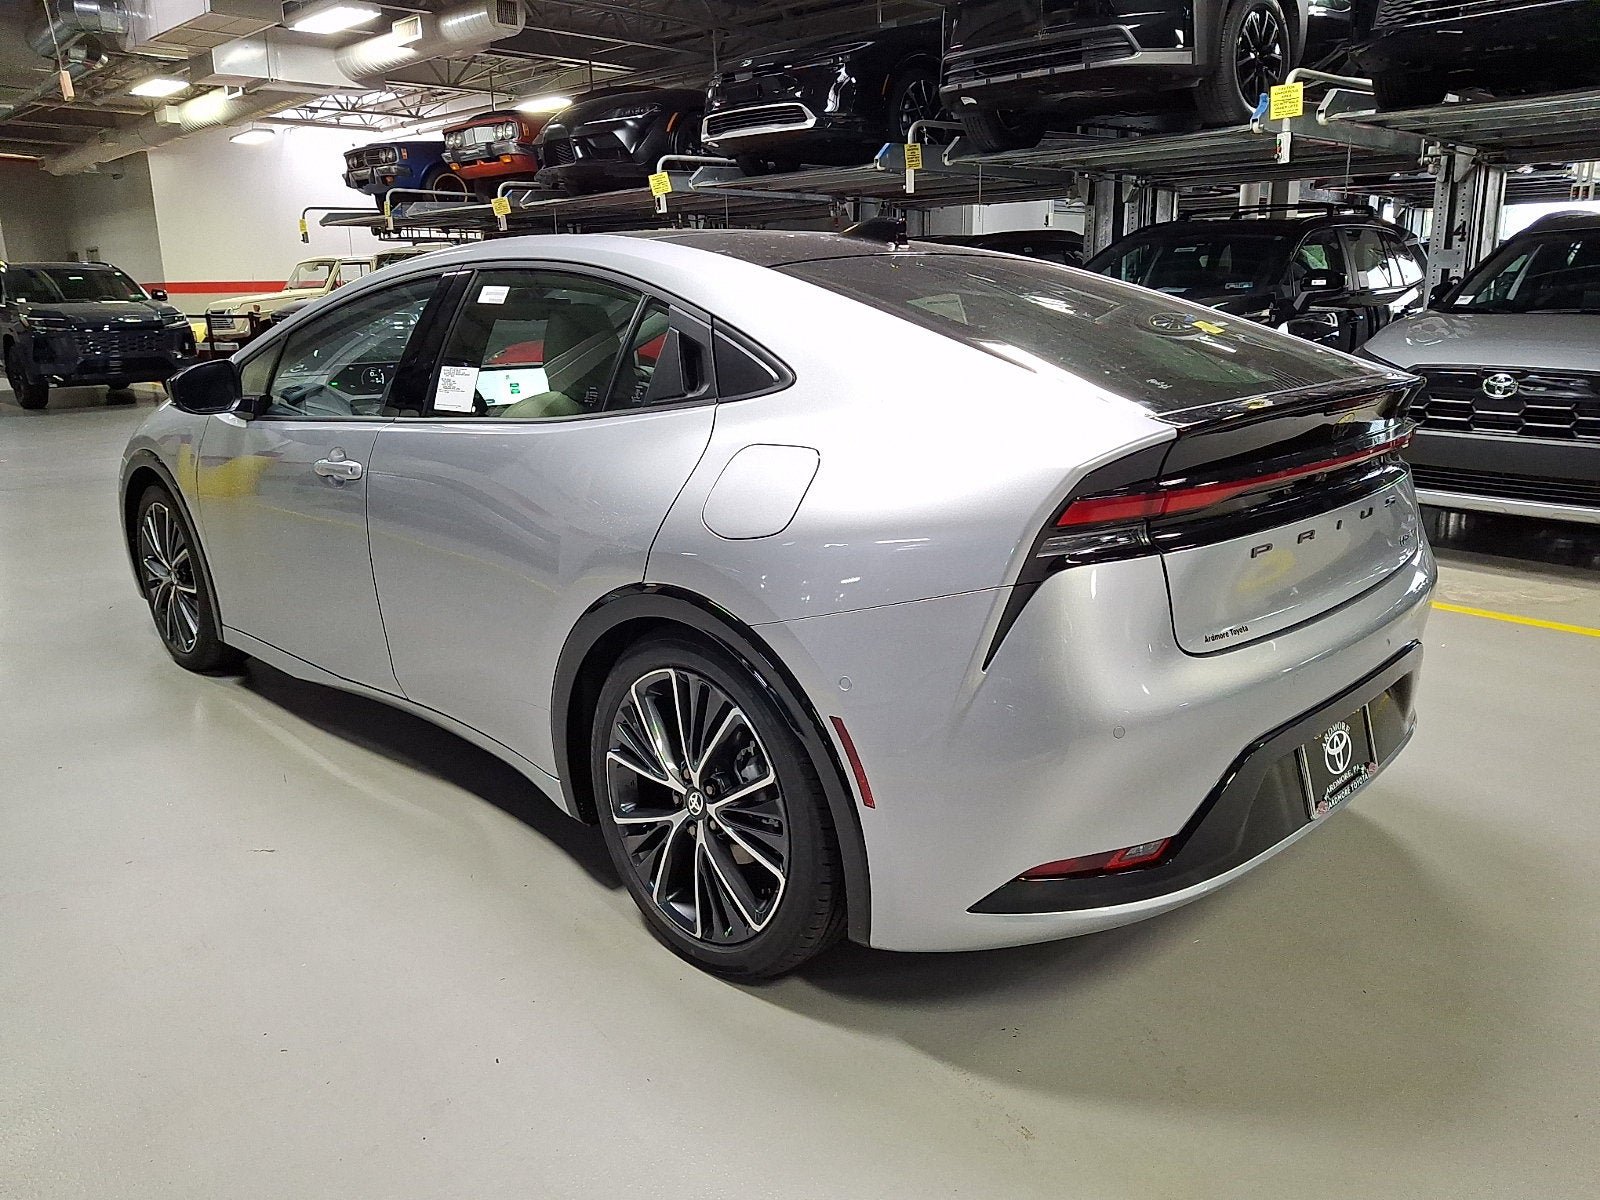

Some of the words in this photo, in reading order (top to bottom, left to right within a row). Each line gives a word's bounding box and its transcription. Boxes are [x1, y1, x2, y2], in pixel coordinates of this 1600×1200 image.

[1452, 220, 1467, 242] 4
[1250, 494, 1397, 559] PRIUS
[1204, 631, 1230, 643] Ardmore
[1229, 625, 1249, 636] Toyota
[1321, 721, 1351, 752] ARDMORE
[1327, 787, 1351, 810] ARDMORE
[1350, 773, 1370, 792] TOYOTA
